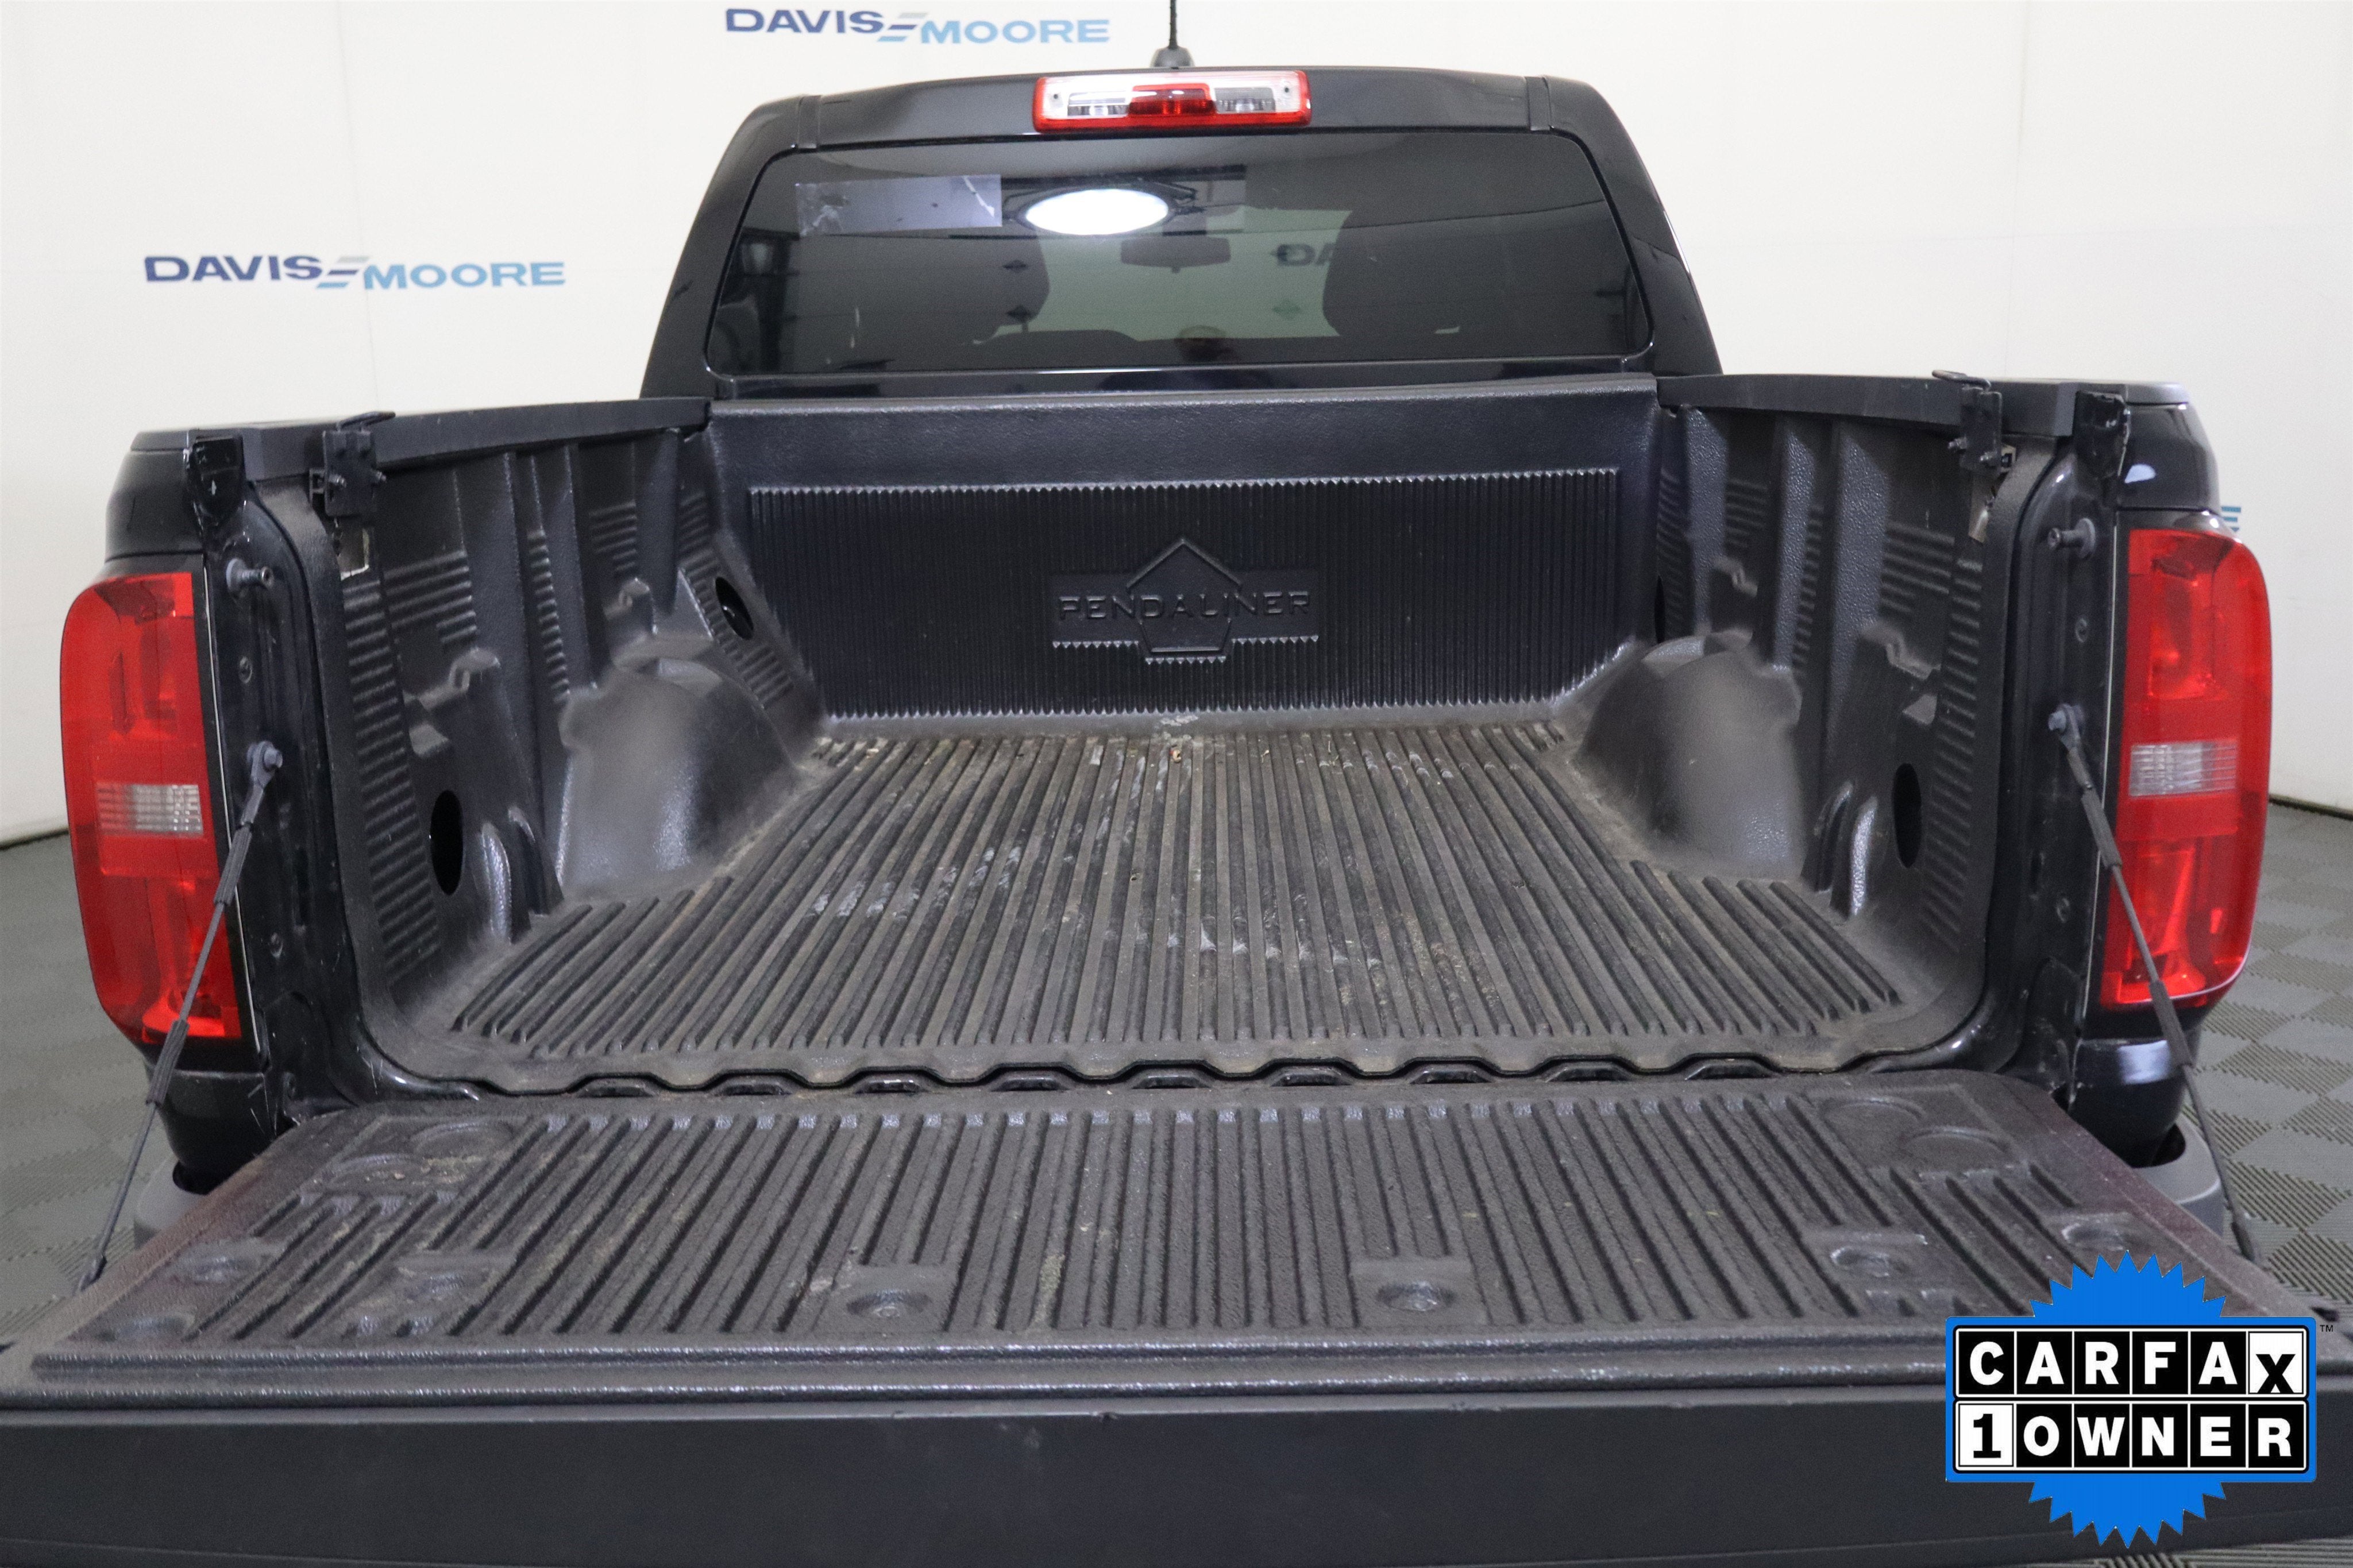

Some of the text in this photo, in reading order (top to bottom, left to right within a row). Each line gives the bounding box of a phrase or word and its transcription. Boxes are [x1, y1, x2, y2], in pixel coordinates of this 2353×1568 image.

[726, 9, 1110, 44] DAVIS MOORE
[144, 255, 566, 290] DAVIS MOORE
[1059, 590, 1310, 620] PENDALINER
